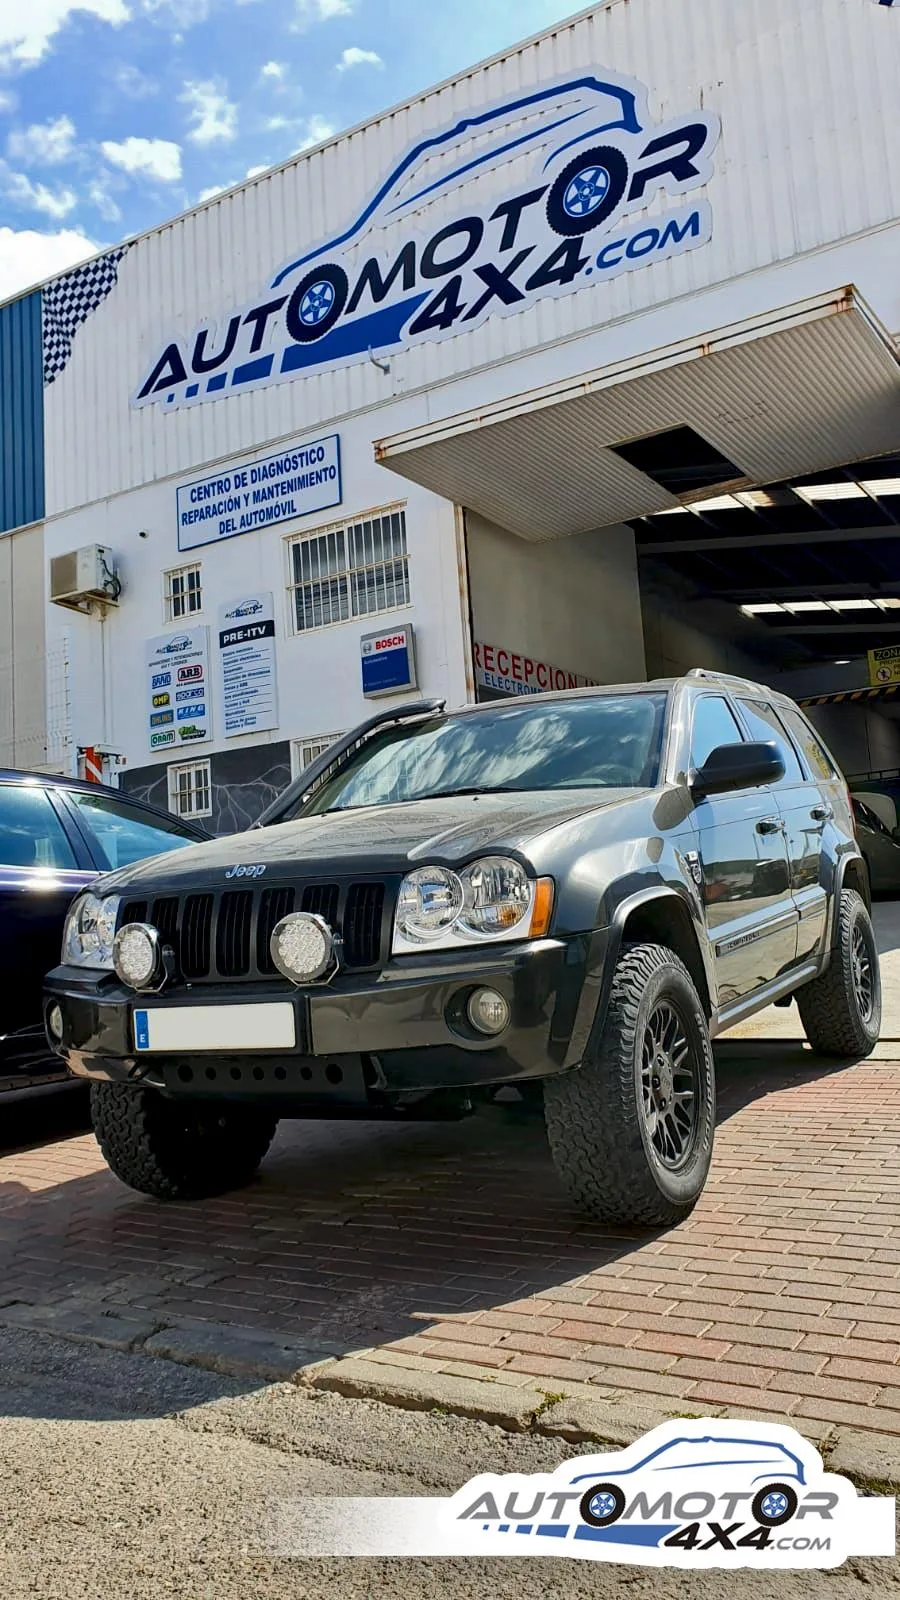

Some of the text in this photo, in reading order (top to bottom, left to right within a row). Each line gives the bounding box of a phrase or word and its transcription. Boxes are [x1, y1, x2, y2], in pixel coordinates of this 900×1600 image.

[137, 123, 708, 399] AUTOMOTOR
[190, 446, 325, 503] CENTRO DE DIAGNÓSTICO
[181, 465, 337, 526] REPARACIÓN Y MANTENIMIENTO
[219, 499, 297, 535] DEL AUTOMÓVIL
[223, 625, 266, 644] PRE-ITV
[375, 635, 405, 650] BOSCH
[876, 647, 900, 659] ZON
[180, 667, 200, 679] ARB
[473, 642, 577, 690] RECEPCION
[153, 695, 169, 705] OMP
[225, 864, 267, 879] Jeep
[139, 1033, 146, 1043] E
